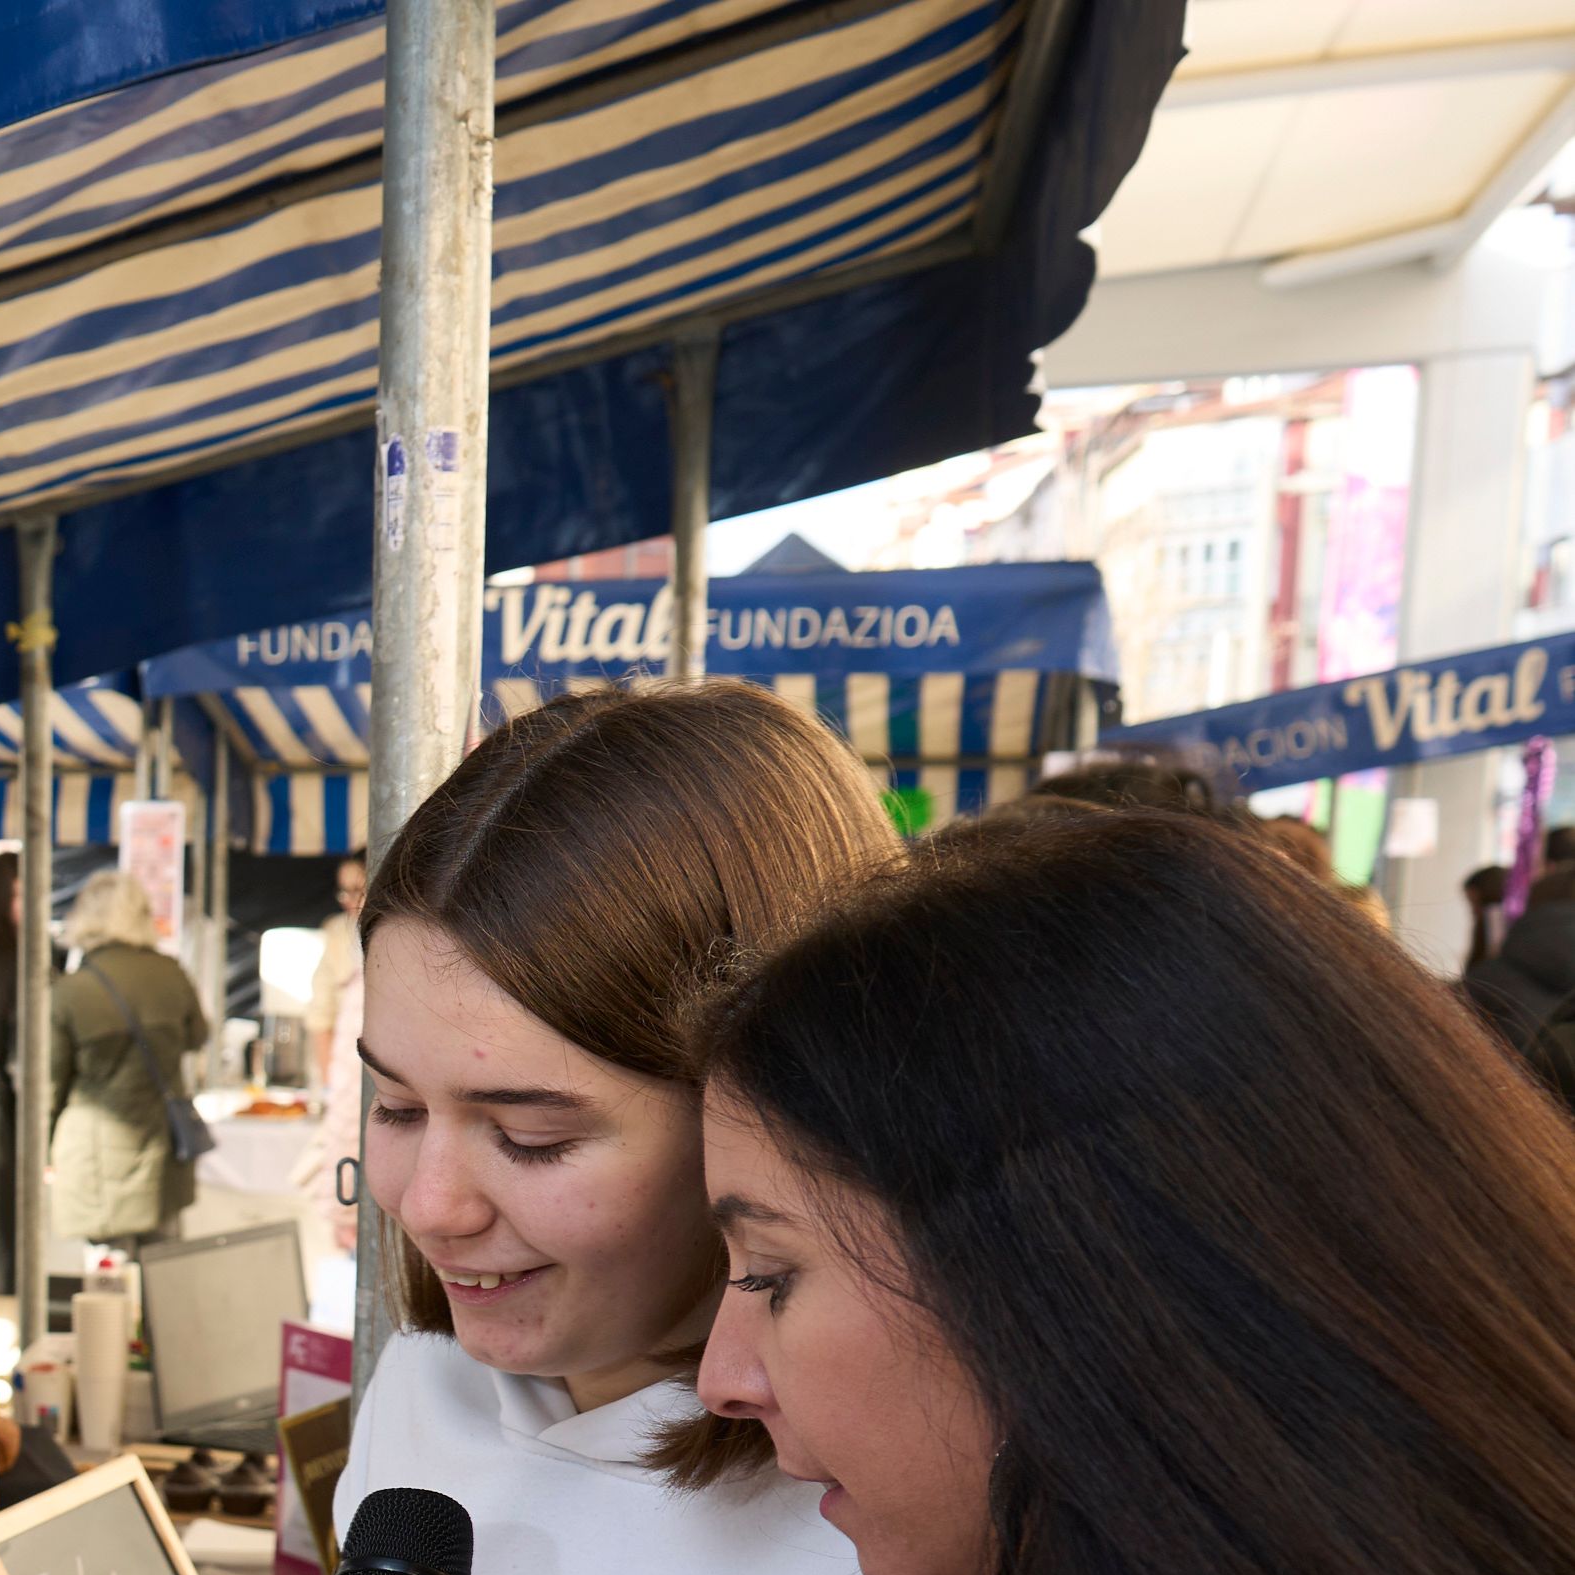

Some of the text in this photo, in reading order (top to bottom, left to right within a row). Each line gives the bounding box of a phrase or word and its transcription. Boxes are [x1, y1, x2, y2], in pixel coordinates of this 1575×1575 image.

[238, 620, 373, 666] FUNDA
[485, 584, 673, 664] Vital
[1345, 647, 1549, 752] Vital
